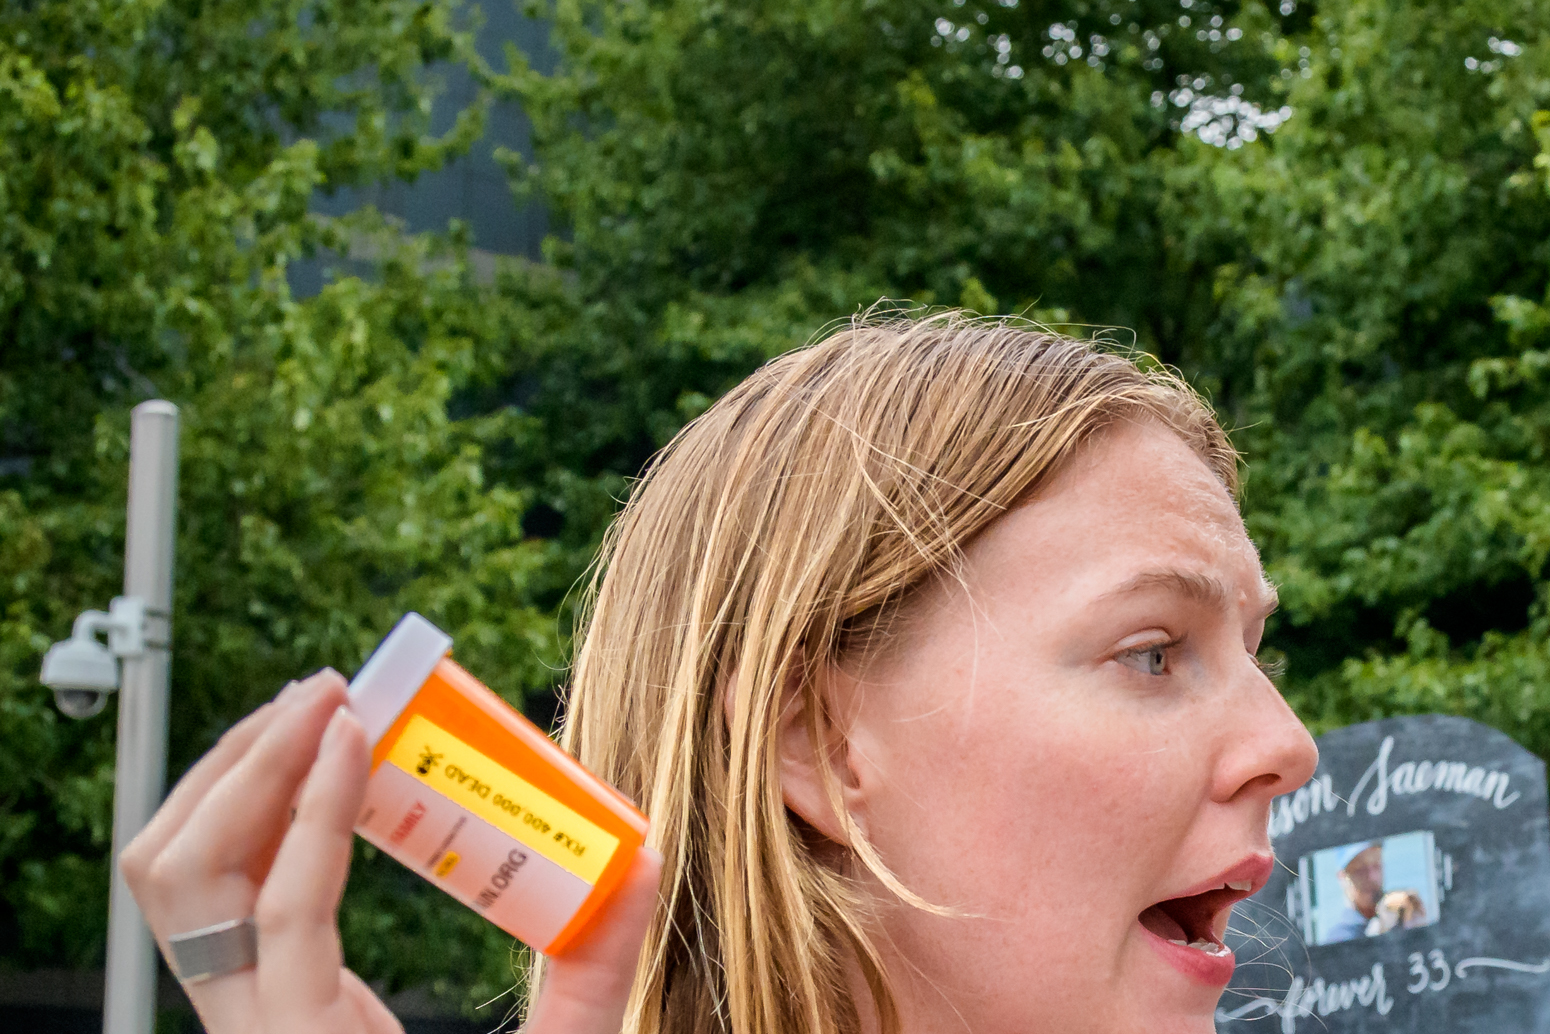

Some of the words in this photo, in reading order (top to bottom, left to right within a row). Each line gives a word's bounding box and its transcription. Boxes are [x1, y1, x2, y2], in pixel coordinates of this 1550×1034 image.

[444, 764, 491, 799] DEAD
[1267, 773, 1339, 838] son
[1406, 949, 1451, 994] 33
